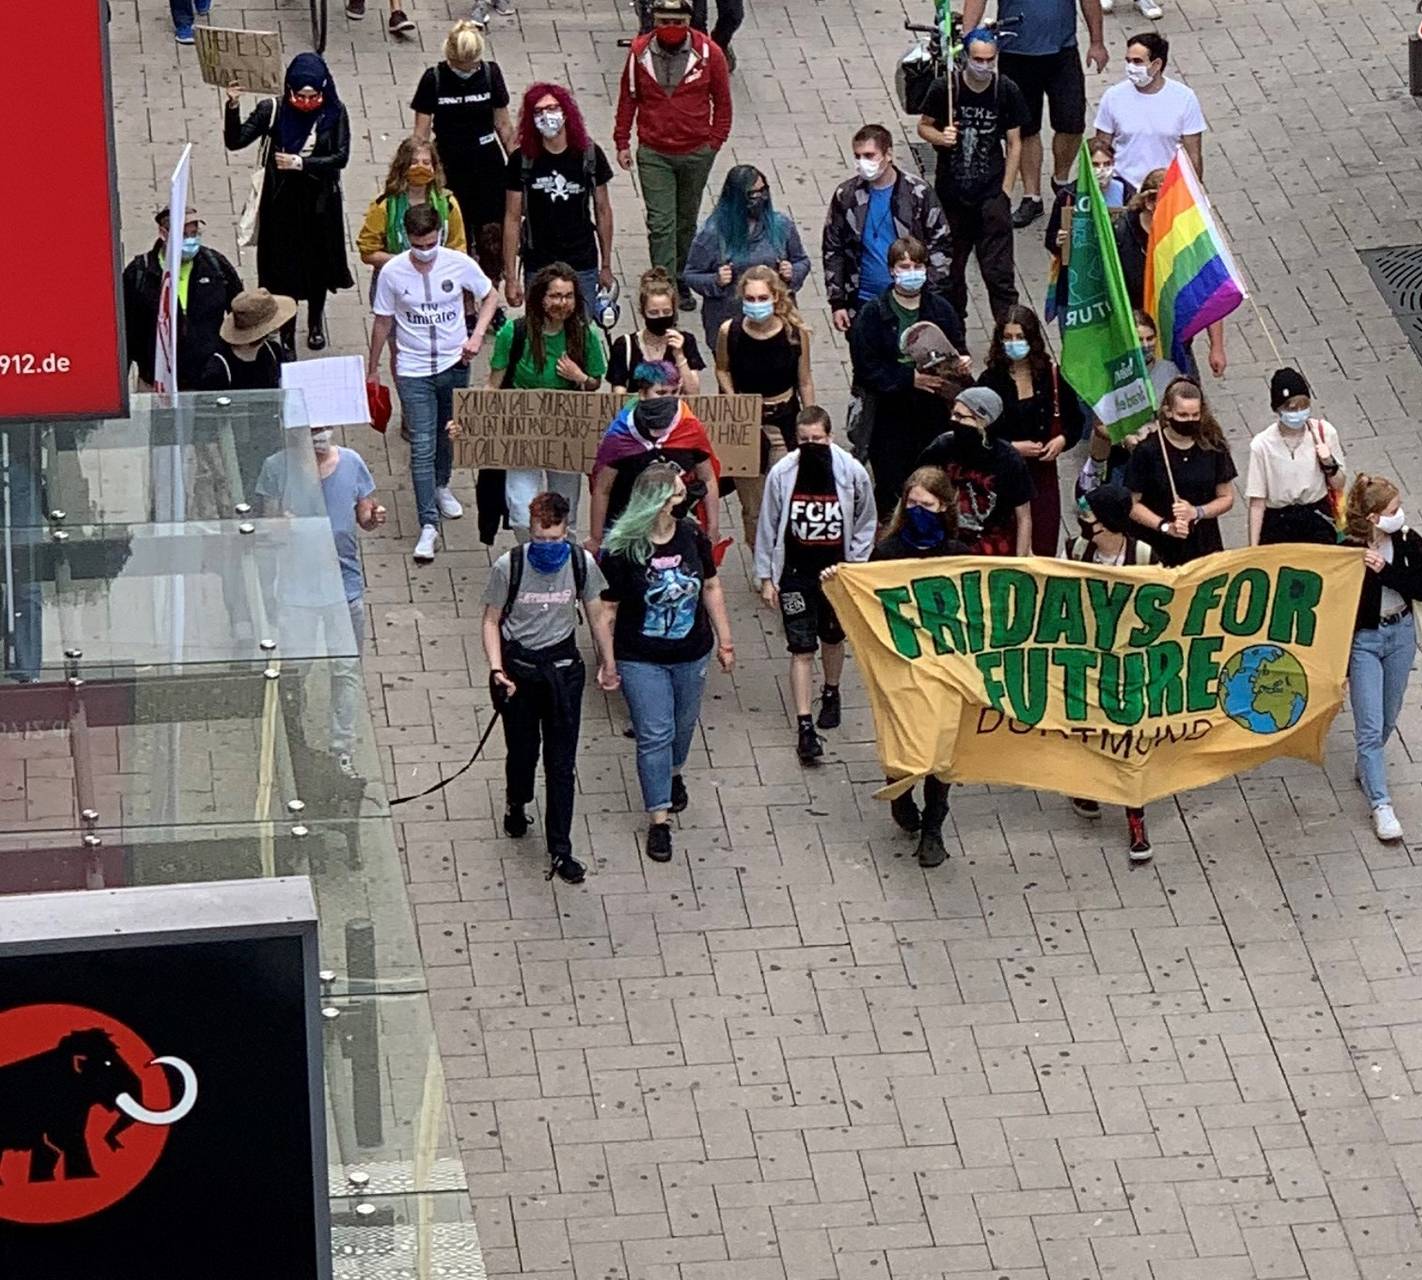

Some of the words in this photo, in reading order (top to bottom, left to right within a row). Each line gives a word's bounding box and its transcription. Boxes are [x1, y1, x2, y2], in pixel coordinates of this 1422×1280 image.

[0, 352, 71, 375] 912.de
[790, 500, 843, 522] FCK
[790, 521, 843, 541] NZS
[874, 567, 1175, 662] FRIDAYS
[1181, 567, 1324, 647] FOR
[975, 635, 1225, 728] FUTURE
